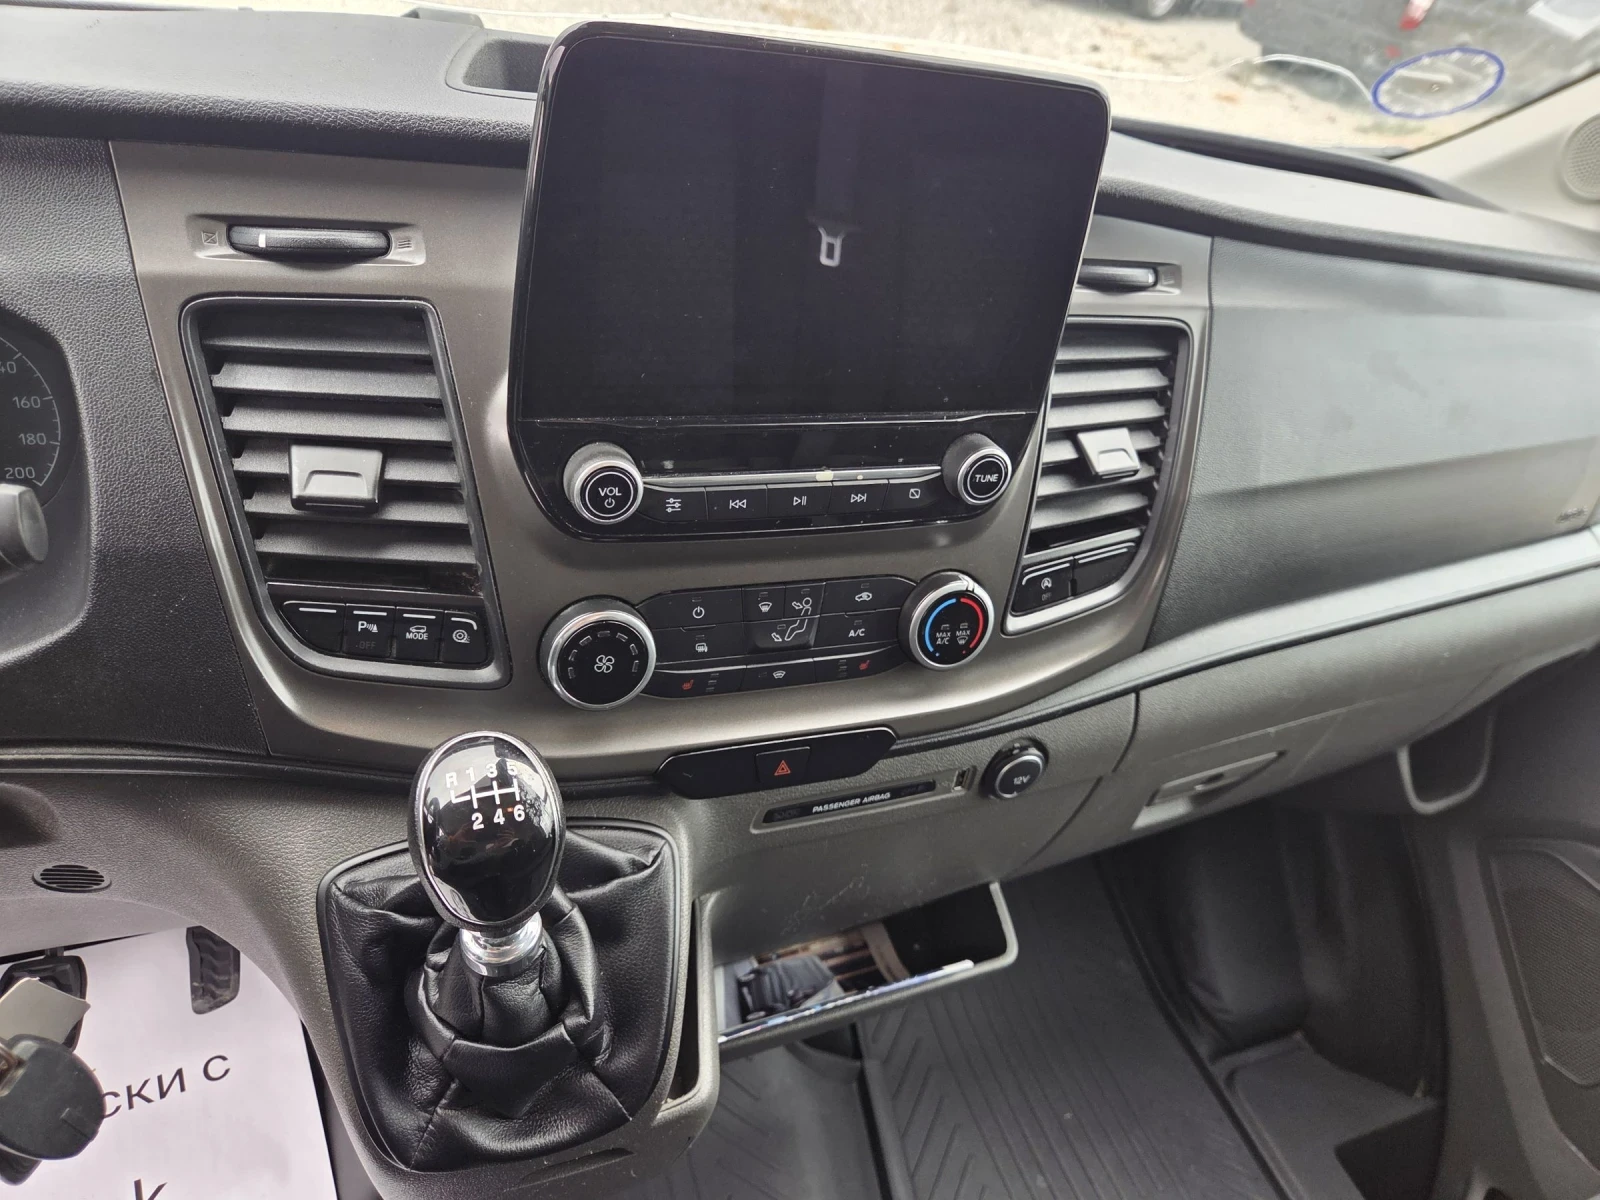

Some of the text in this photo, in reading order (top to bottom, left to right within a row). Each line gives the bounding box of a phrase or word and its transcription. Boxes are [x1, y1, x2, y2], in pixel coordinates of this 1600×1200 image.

[12, 395, 41, 409] 160
[18, 432, 47, 446] 180
[4, 466, 36, 479] 200
[974, 473, 1000, 483] TUNE
[598, 486, 622, 497] VOL
[405, 631, 429, 640] MODE
[848, 628, 866, 638] A/C
[955, 629, 971, 637] MAX
[359, 641, 376, 650] OFF
[936, 637, 950, 645] A/C
[445, 761, 518, 788] R 1 3 5
[1013, 774, 1031, 785] 12V
[812, 792, 891, 814] PASSENGER AIRBAG
[471, 804, 525, 830] 2 4 6
